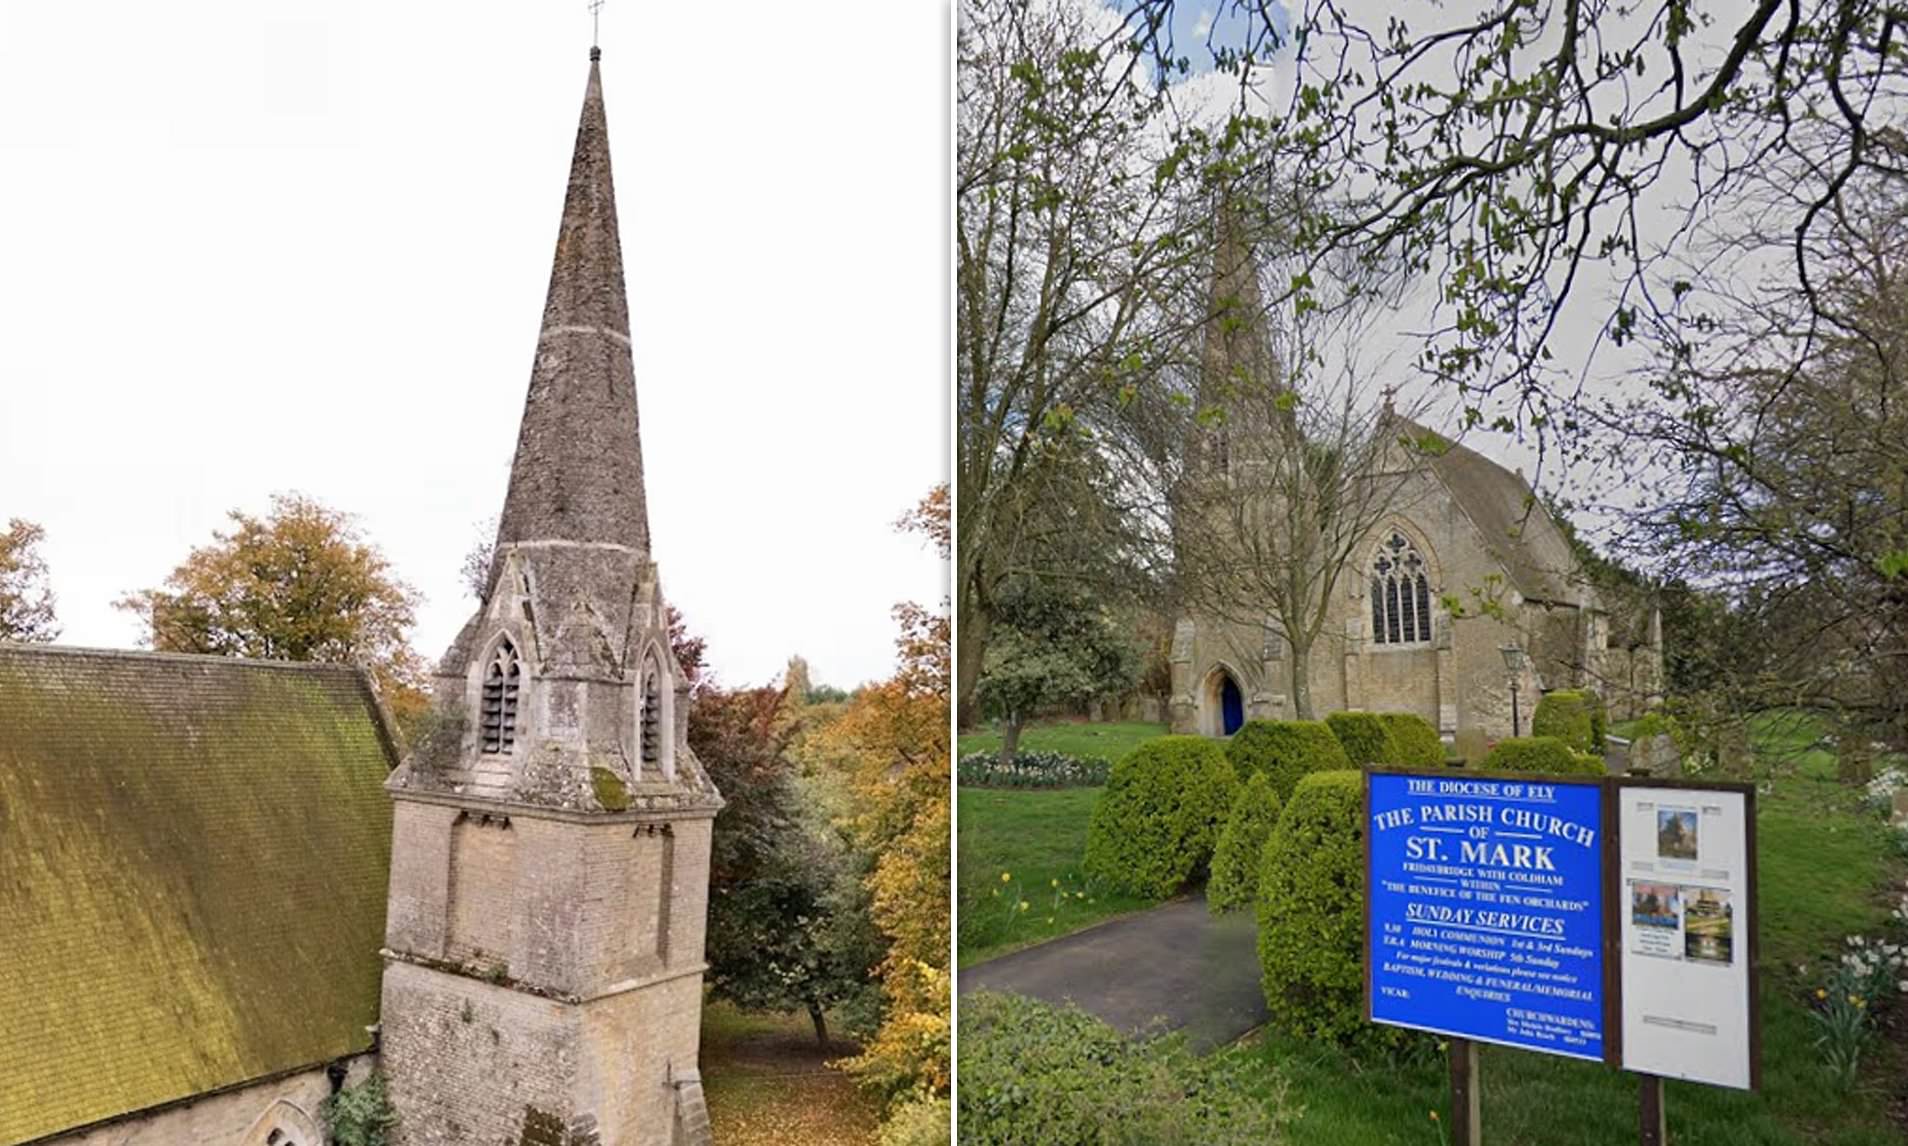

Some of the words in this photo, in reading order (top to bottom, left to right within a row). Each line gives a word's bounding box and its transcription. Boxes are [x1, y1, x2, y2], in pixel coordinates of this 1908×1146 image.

[1408, 780, 1435, 793] THE
[1440, 782, 1499, 796] DIOCESE
[1503, 785, 1523, 798] OF
[1528, 785, 1556, 800] ELY
[1374, 807, 1414, 831] THE
[1420, 804, 1493, 823] PARISH
[1500, 808, 1595, 848] CHURCH
[1468, 826, 1490, 840] OF
[1406, 836, 1448, 862] ST.
[1460, 841, 1556, 871] MARK
[1402, 862, 1475, 877] FRIDAYBRIDGE
[1477, 869, 1506, 880] WITH
[1507, 871, 1564, 886] COLDHAM
[1460, 878, 1501, 891] WITHIN
[1408, 884, 1456, 898] BENEFICE
[1458, 890, 1473, 900] OF
[1475, 891, 1497, 902] THE
[1499, 894, 1521, 905] FEN
[1405, 902, 1474, 924] SUNDAY
[1475, 910, 1566, 935] SERVICES
[1409, 939, 1458, 954] MORNING
[1458, 946, 1506, 961] WORSHIP
[1525, 955, 1560, 970] Sunday
[1411, 926, 1439, 938] HOLY
[1440, 929, 1505, 946] COMMUNION
[1553, 944, 1594, 959] Sundays
[1427, 968, 1474, 985] WEDDING
[1485, 977, 1593, 1001] FUNERAL/MEMORIAL
[1456, 985, 1512, 1003] ENQUIRIES
